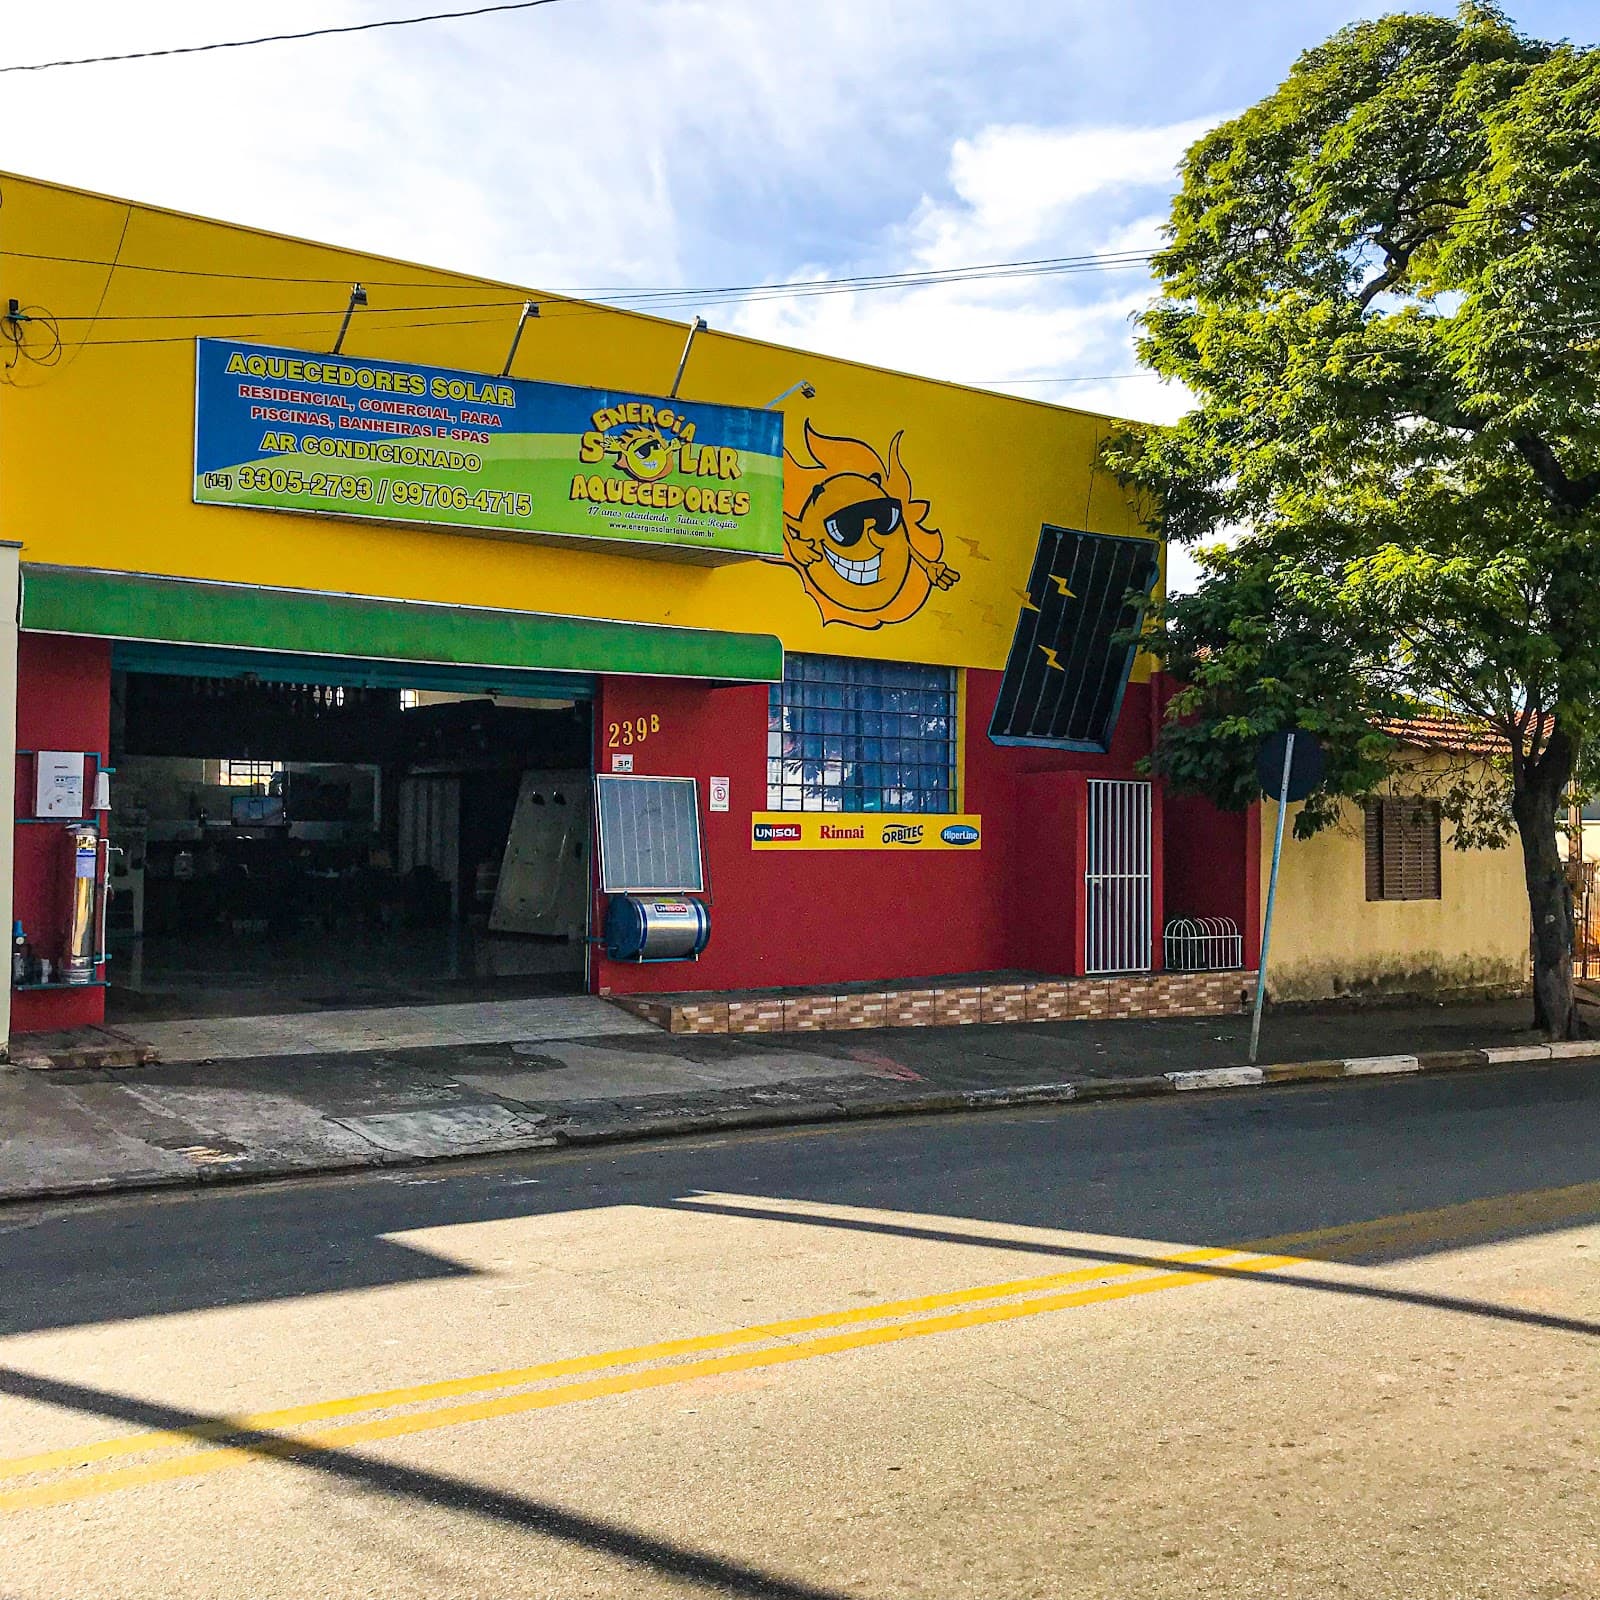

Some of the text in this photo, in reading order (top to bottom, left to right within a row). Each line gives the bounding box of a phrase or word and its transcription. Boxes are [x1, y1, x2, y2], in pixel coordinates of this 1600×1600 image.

[226, 353, 516, 408] AQUECEDORES SOLAR
[238, 384, 502, 427] RESIDENCIAL, COMERCIAL, PARA
[251, 407, 490, 444] PISCINAS, BANHEIRAS E SPAS
[260, 431, 483, 473] AR CONDICIONADO
[203, 471, 233, 491] (15)
[238, 466, 373, 502] 3305-2793
[391, 480, 532, 518] 99706-4715
[570, 473, 751, 515] AQUECEDORES
[587, 506, 600, 516] 17
[601, 510, 622, 518] anos
[624, 510, 669, 523] atendendo
[755, 824, 978, 844] UNISOL Rinnai ORBITEC HiperLine
